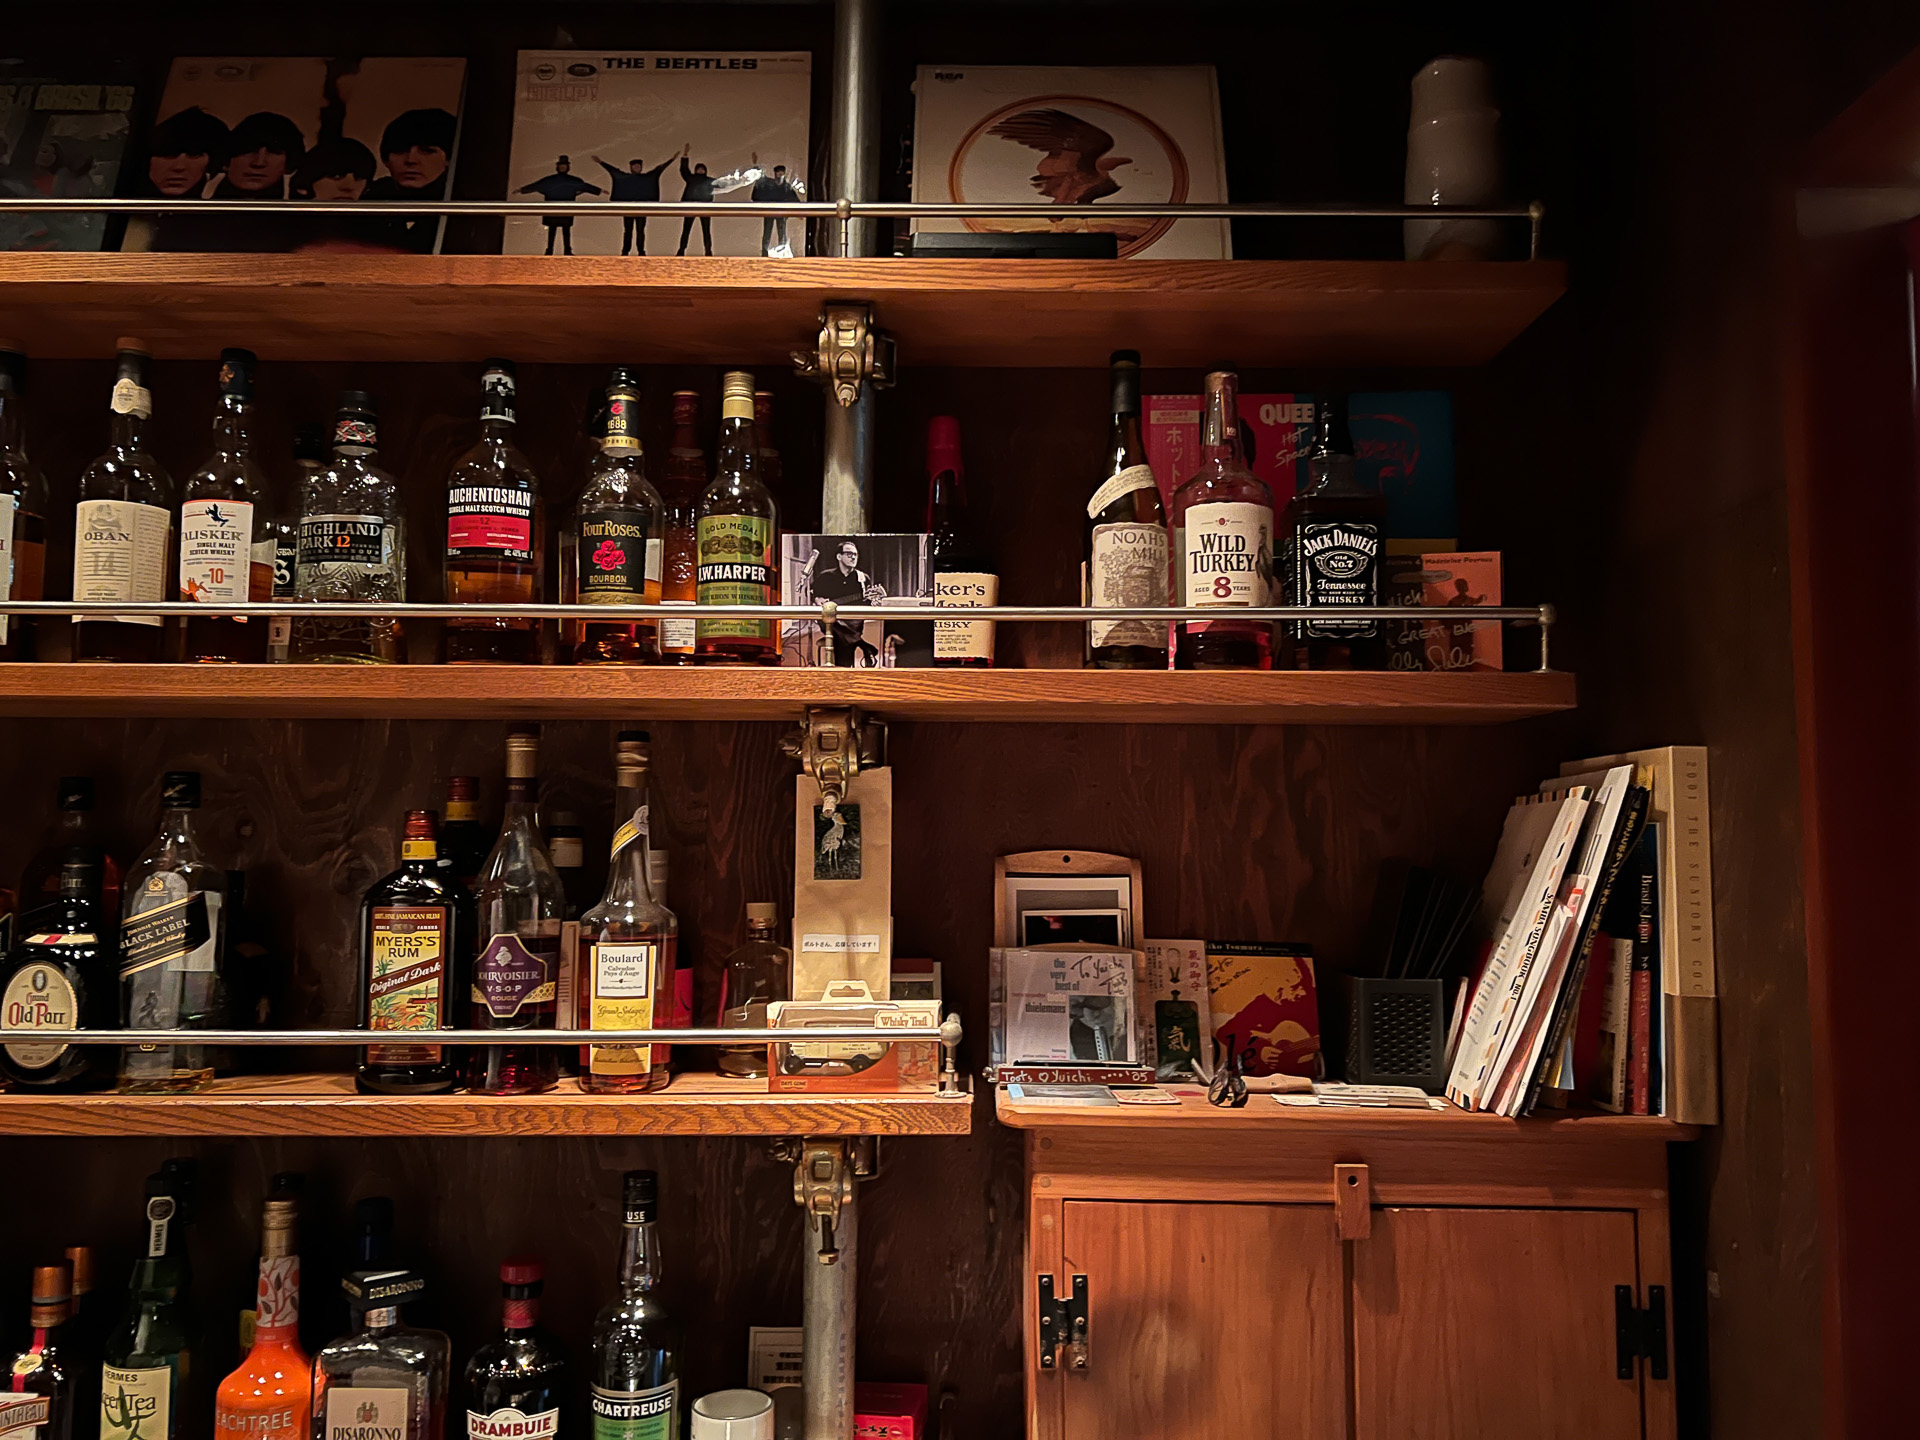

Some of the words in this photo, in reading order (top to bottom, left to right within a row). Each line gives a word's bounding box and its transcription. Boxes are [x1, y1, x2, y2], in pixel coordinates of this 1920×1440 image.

[603, 58, 645, 68] THE
[655, 58, 757, 69] BEATLES
[1260, 403, 1315, 426] QUEE
[449, 487, 531, 507] AUCHENTOSHAN
[481, 505, 505, 513] SCOTCH
[301, 523, 381, 537] HIGHLAND
[582, 521, 604, 537] Four
[705, 523, 726, 535] GOLD
[729, 522, 758, 536] MEDAL
[84, 532, 130, 542] OBAN
[301, 536, 334, 549] PARK
[337, 535, 351, 547] 12
[1113, 532, 1165, 547] NOAHS
[1200, 533, 1246, 553] WILD
[1303, 533, 1334, 556] JACK
[1333, 529, 1379, 556] DANIEL'S
[1190, 551, 1255, 573] TURKEY
[209, 568, 224, 584] 10
[589, 575, 627, 584] BOURBON
[935, 583, 986, 596] ker's
[1213, 577, 1232, 598] 8
[1317, 579, 1367, 590] Tennessee
[1318, 596, 1366, 604] WHISKEY
[1537, 892, 1555, 926] SAMBA
[1689, 863, 1702, 943] SUNTORY
[155, 918, 191, 937] LABEL
[376, 936, 437, 947] MYERS'S
[389, 948, 419, 958] RUM
[601, 953, 643, 963] Boulard
[1054, 958, 1066, 968] the
[370, 976, 409, 995] Original
[410, 962, 442, 982] Dark
[9, 1002, 33, 1026] Old
[35, 1002, 67, 1027] Parr
[881, 1016, 909, 1028] Whisky
[909, 1016, 928, 1027] Trail
[1001, 1070, 1033, 1083] Toots
[1051, 1070, 1091, 1083] Yuichi
[626, 1211, 645, 1220] USE
[368, 1278, 425, 1300] DISARONNO
[124, 1393, 156, 1411] Tea
[592, 1396, 672, 1418] CHARTREUSE
[333, 1427, 401, 1440] DISARONNO
[471, 1417, 552, 1437] DRAMBUIE
